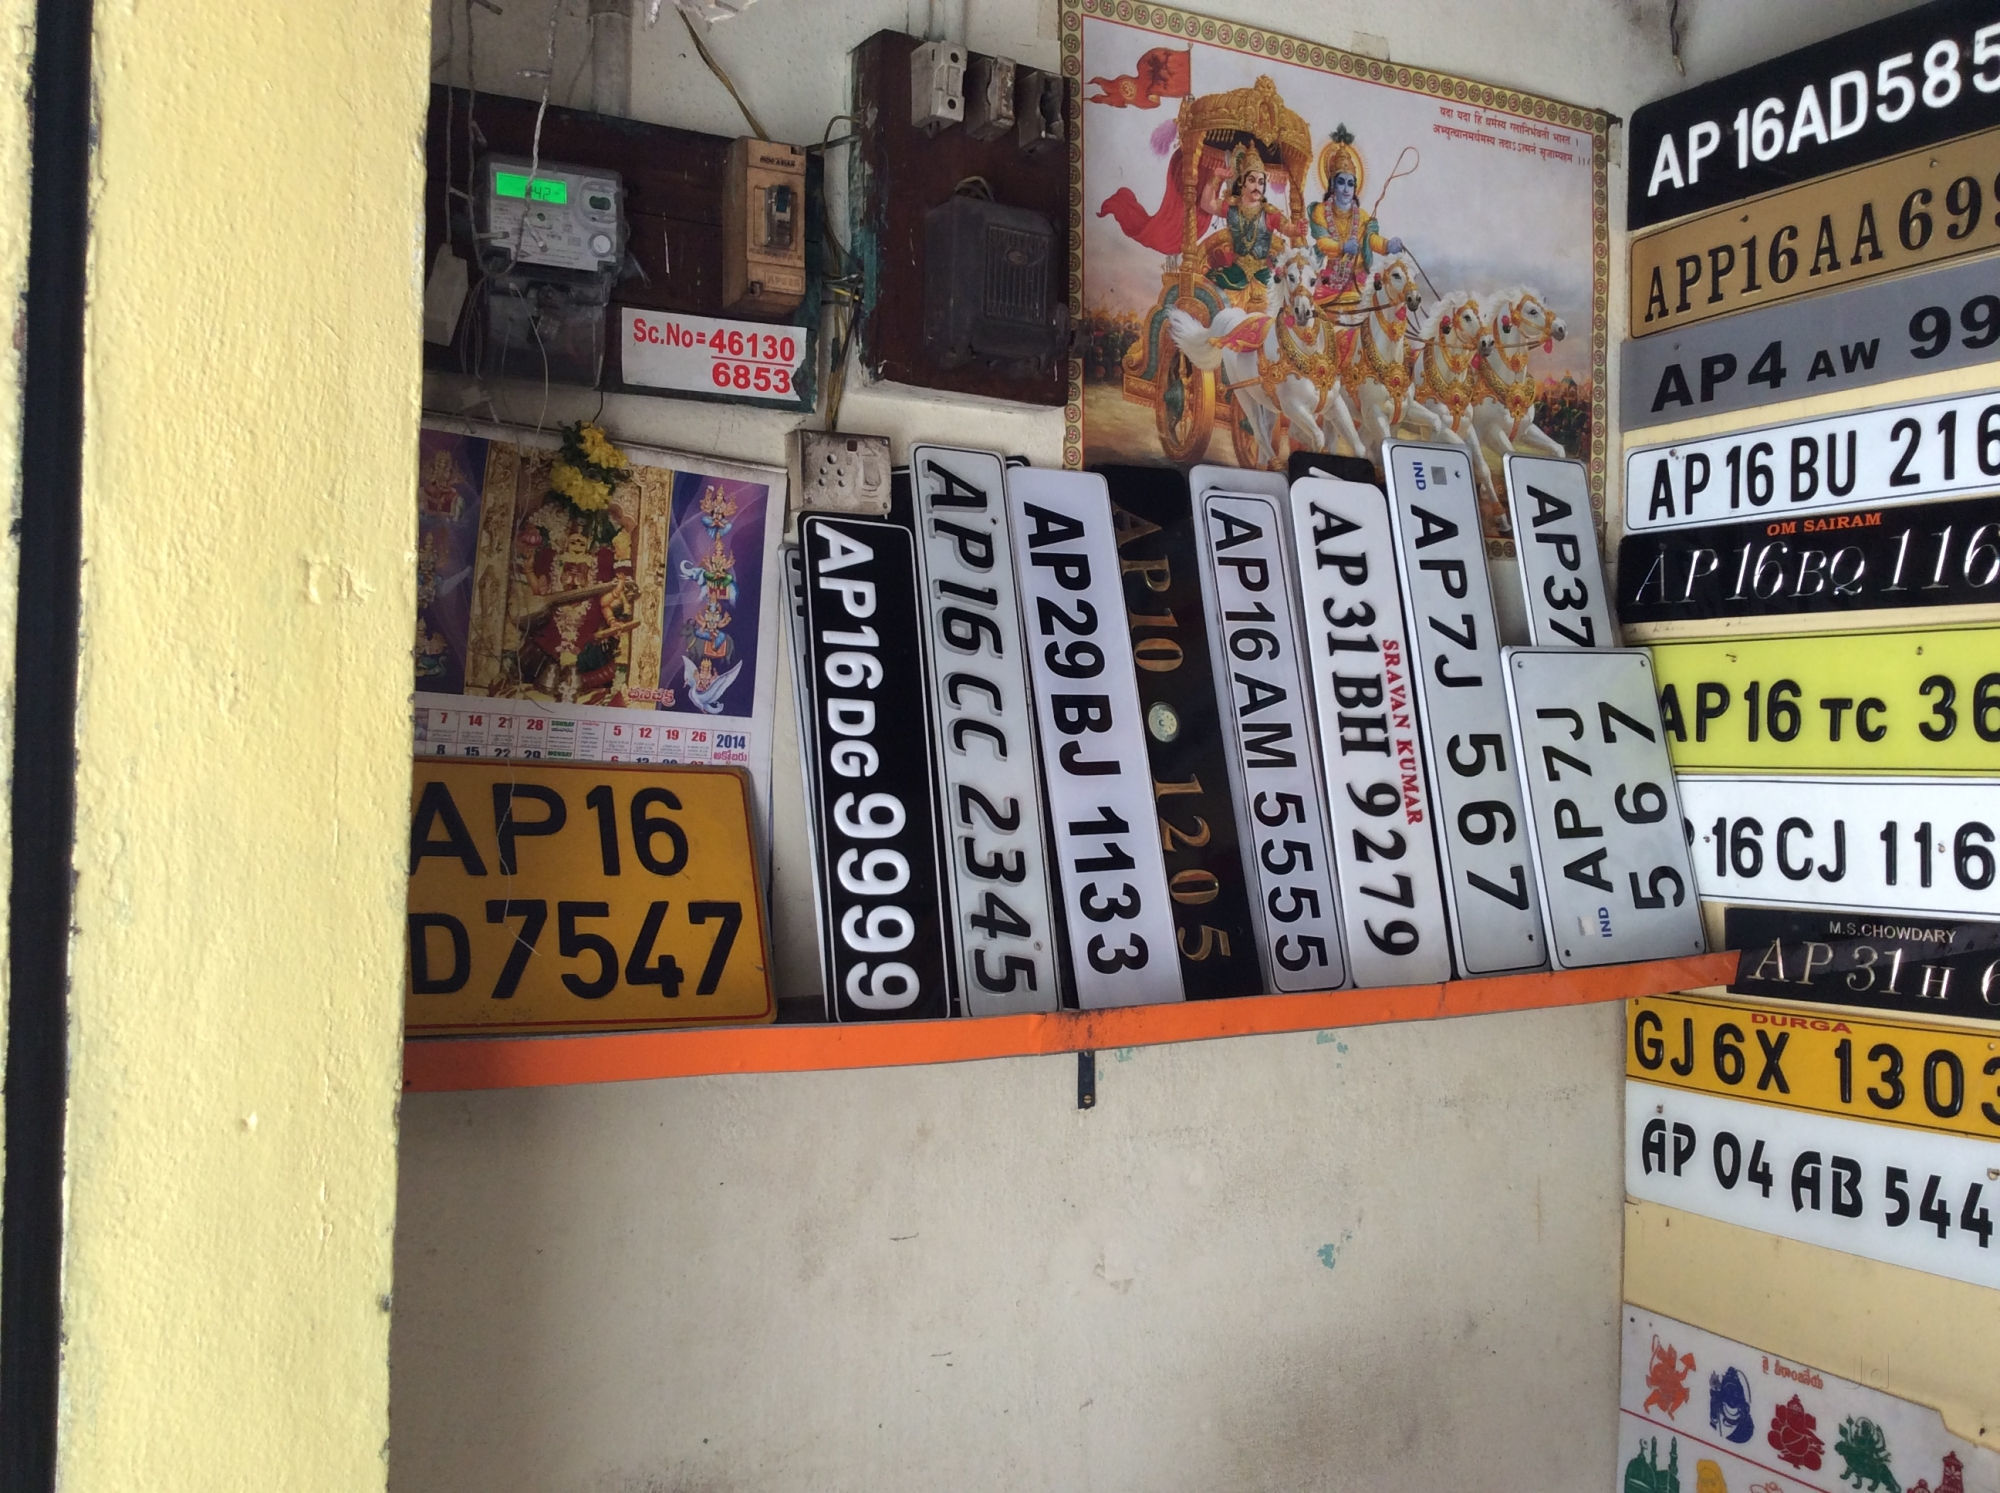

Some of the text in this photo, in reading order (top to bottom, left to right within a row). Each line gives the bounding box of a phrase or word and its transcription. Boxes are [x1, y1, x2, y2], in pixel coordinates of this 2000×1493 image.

[711, 362, 793, 394] 6853
[1412, 461, 1426, 491] IND
[1766, 512, 1882, 536] OM SAIRAM
[1526, 484, 1596, 648] AP37
[440, 712, 448, 724] 7
[468, 714, 483, 727] 14
[498, 716, 513, 729] 21
[526, 718, 544, 731] 28
[613, 725, 622, 737] 5
[638, 727, 652, 739] 12
[1382, 639, 1423, 825] SRAVAN KUMAR
[665, 729, 679, 741] 19
[691, 730, 707, 743] 26
[716, 734, 746, 750] 2014
[464, 746, 480, 757] 15
[1446, 732, 1531, 911] 567
[1597, 700, 1686, 911] 567
[409, 781, 690, 877] AP16
[1153, 773, 1232, 962] 1205
[1345, 782, 1420, 956] 9279
[1880, 820, 1996, 891] 116
[954, 783, 1039, 995] 2345
[1068, 805, 1150, 975] 1133
[1254, 791, 1329, 972] 5555
[832, 791, 920, 1010] 9999
[1599, 907, 1613, 939] IND
[1751, 1013, 1852, 1034] DURGA
[1884, 1165, 1993, 1249] 544
